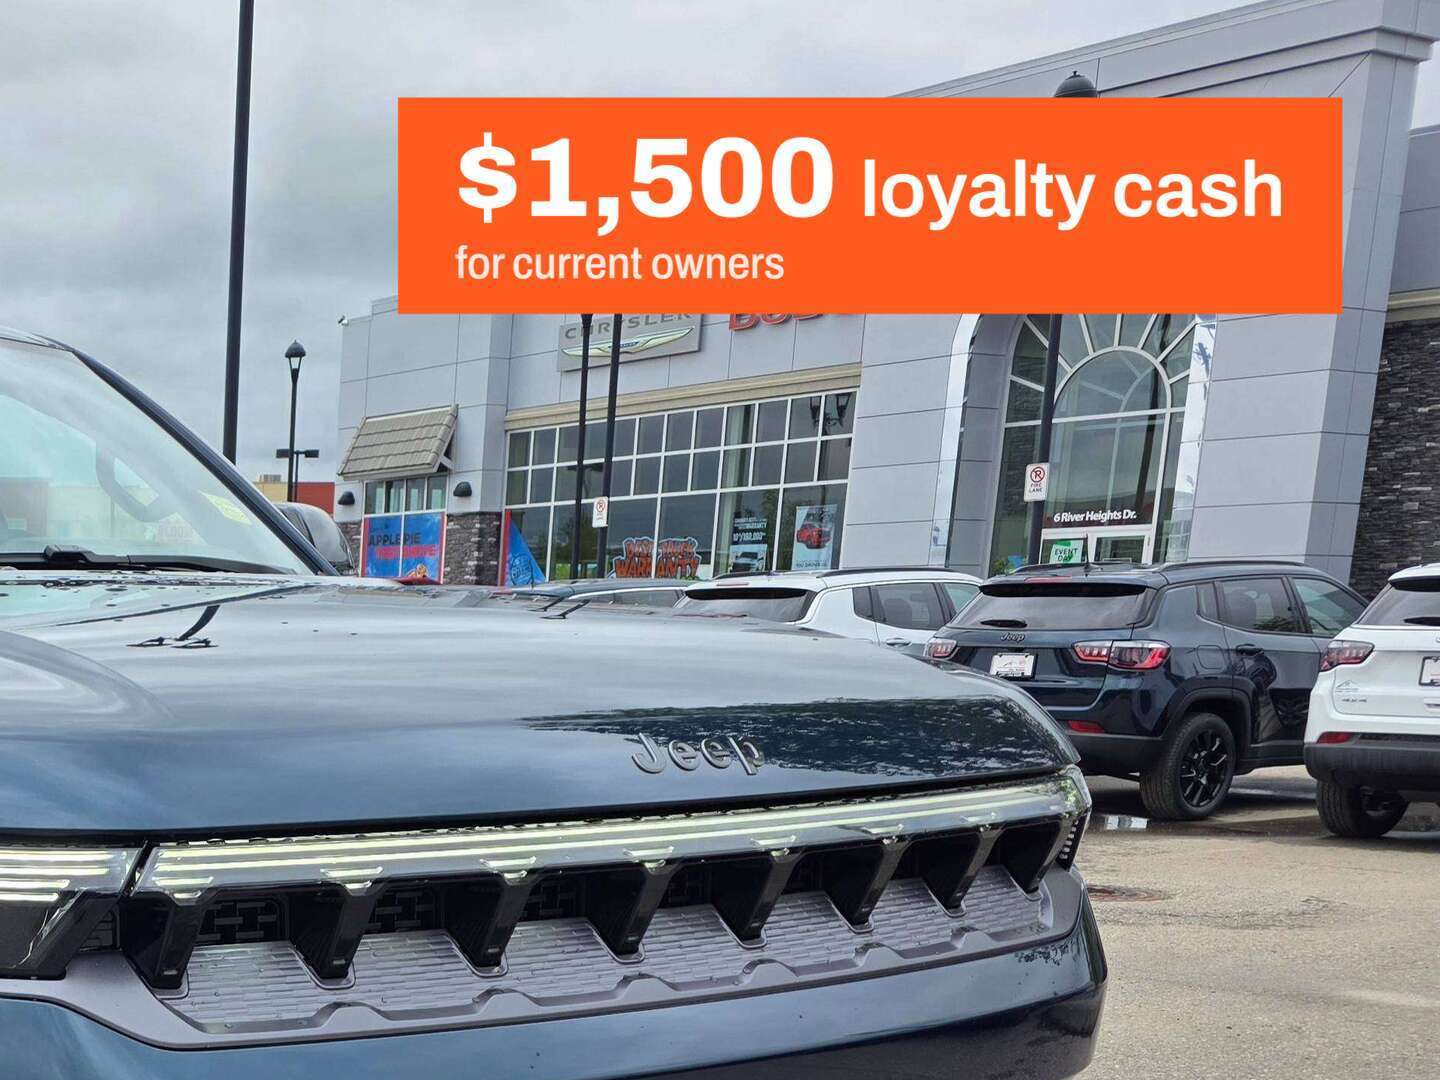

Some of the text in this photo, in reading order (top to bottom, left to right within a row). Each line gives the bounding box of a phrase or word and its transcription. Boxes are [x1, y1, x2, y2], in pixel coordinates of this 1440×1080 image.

[1053, 509, 1137, 522] 6 River Heights Dr.
[369, 532, 422, 546] APPLE PIE
[1000, 631, 1026, 643] Jeep
[632, 732, 766, 776] Jeep
